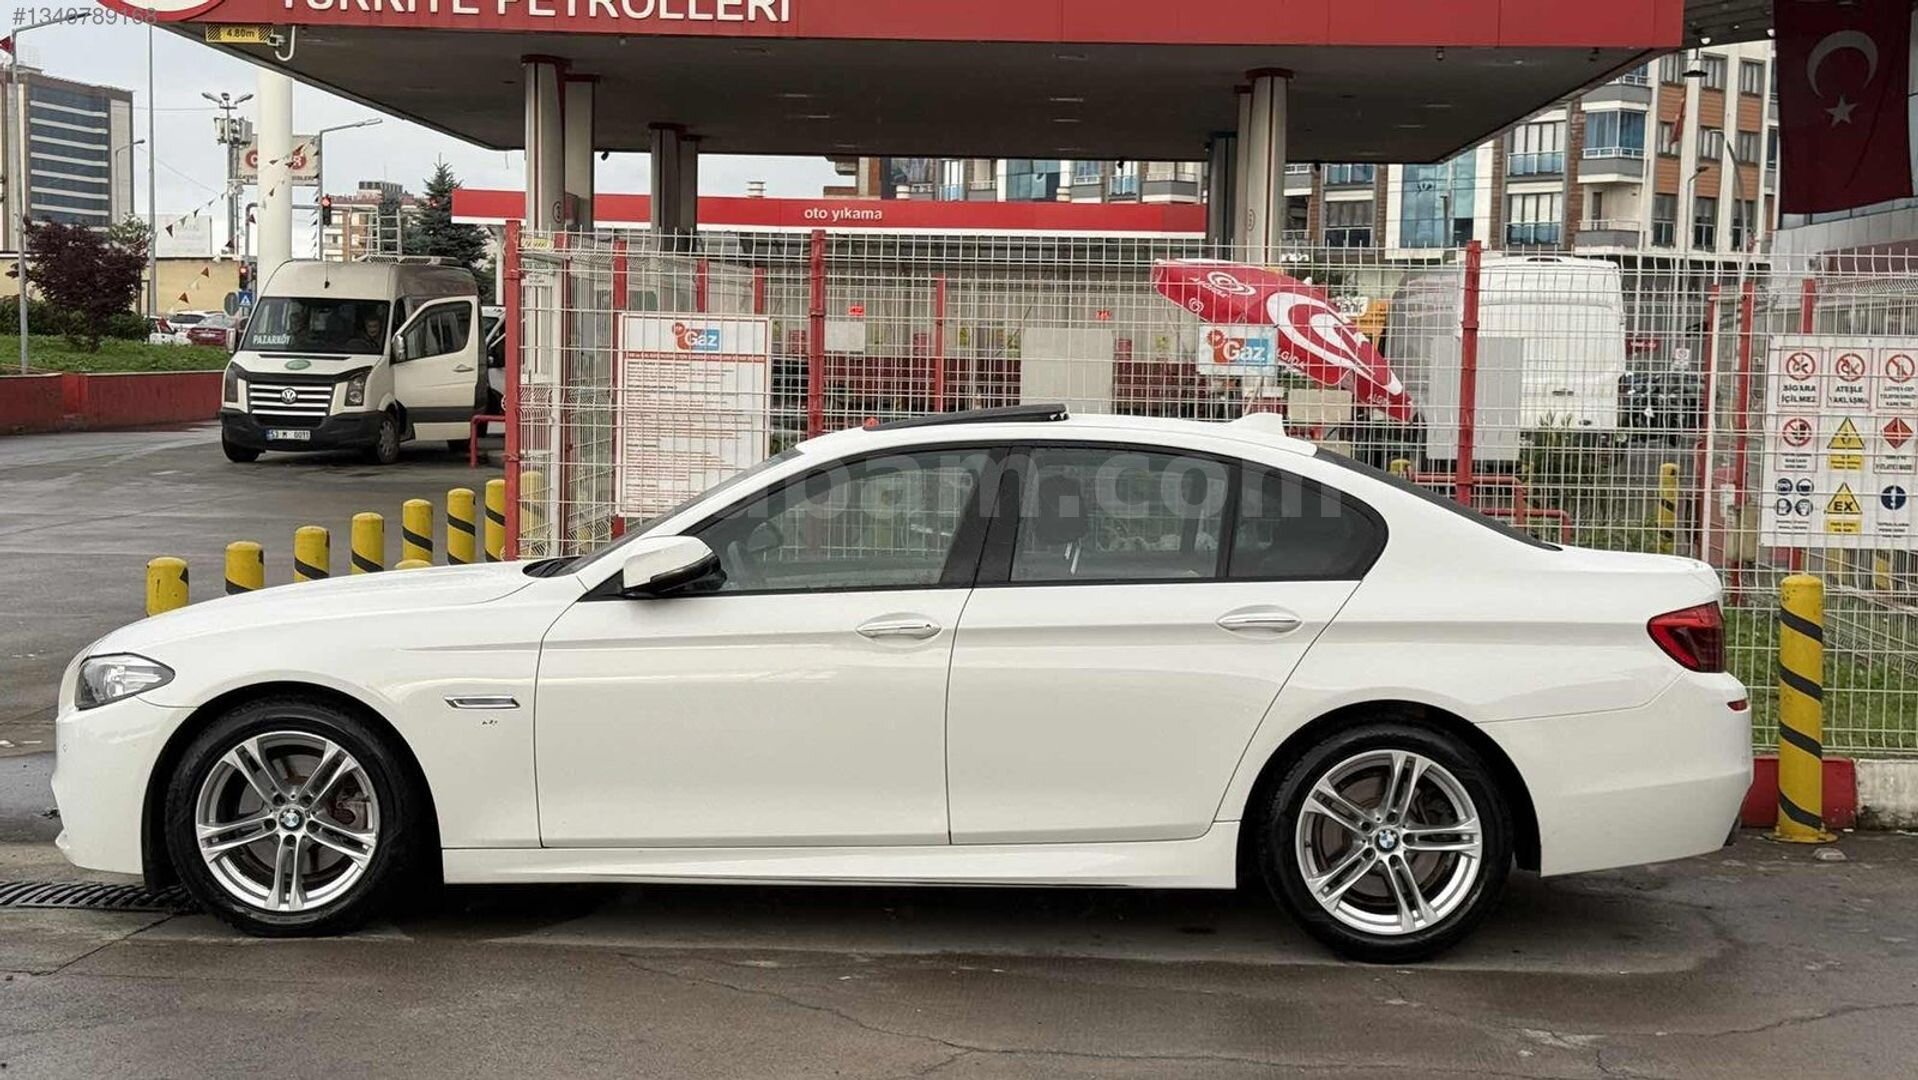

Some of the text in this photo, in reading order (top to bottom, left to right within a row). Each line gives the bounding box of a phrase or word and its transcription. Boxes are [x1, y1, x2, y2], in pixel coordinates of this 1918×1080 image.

[804, 207, 828, 219] oto
[684, 331, 718, 347] Gaz
[1222, 341, 1266, 361] Gaz
[1833, 500, 1854, 512] EX
